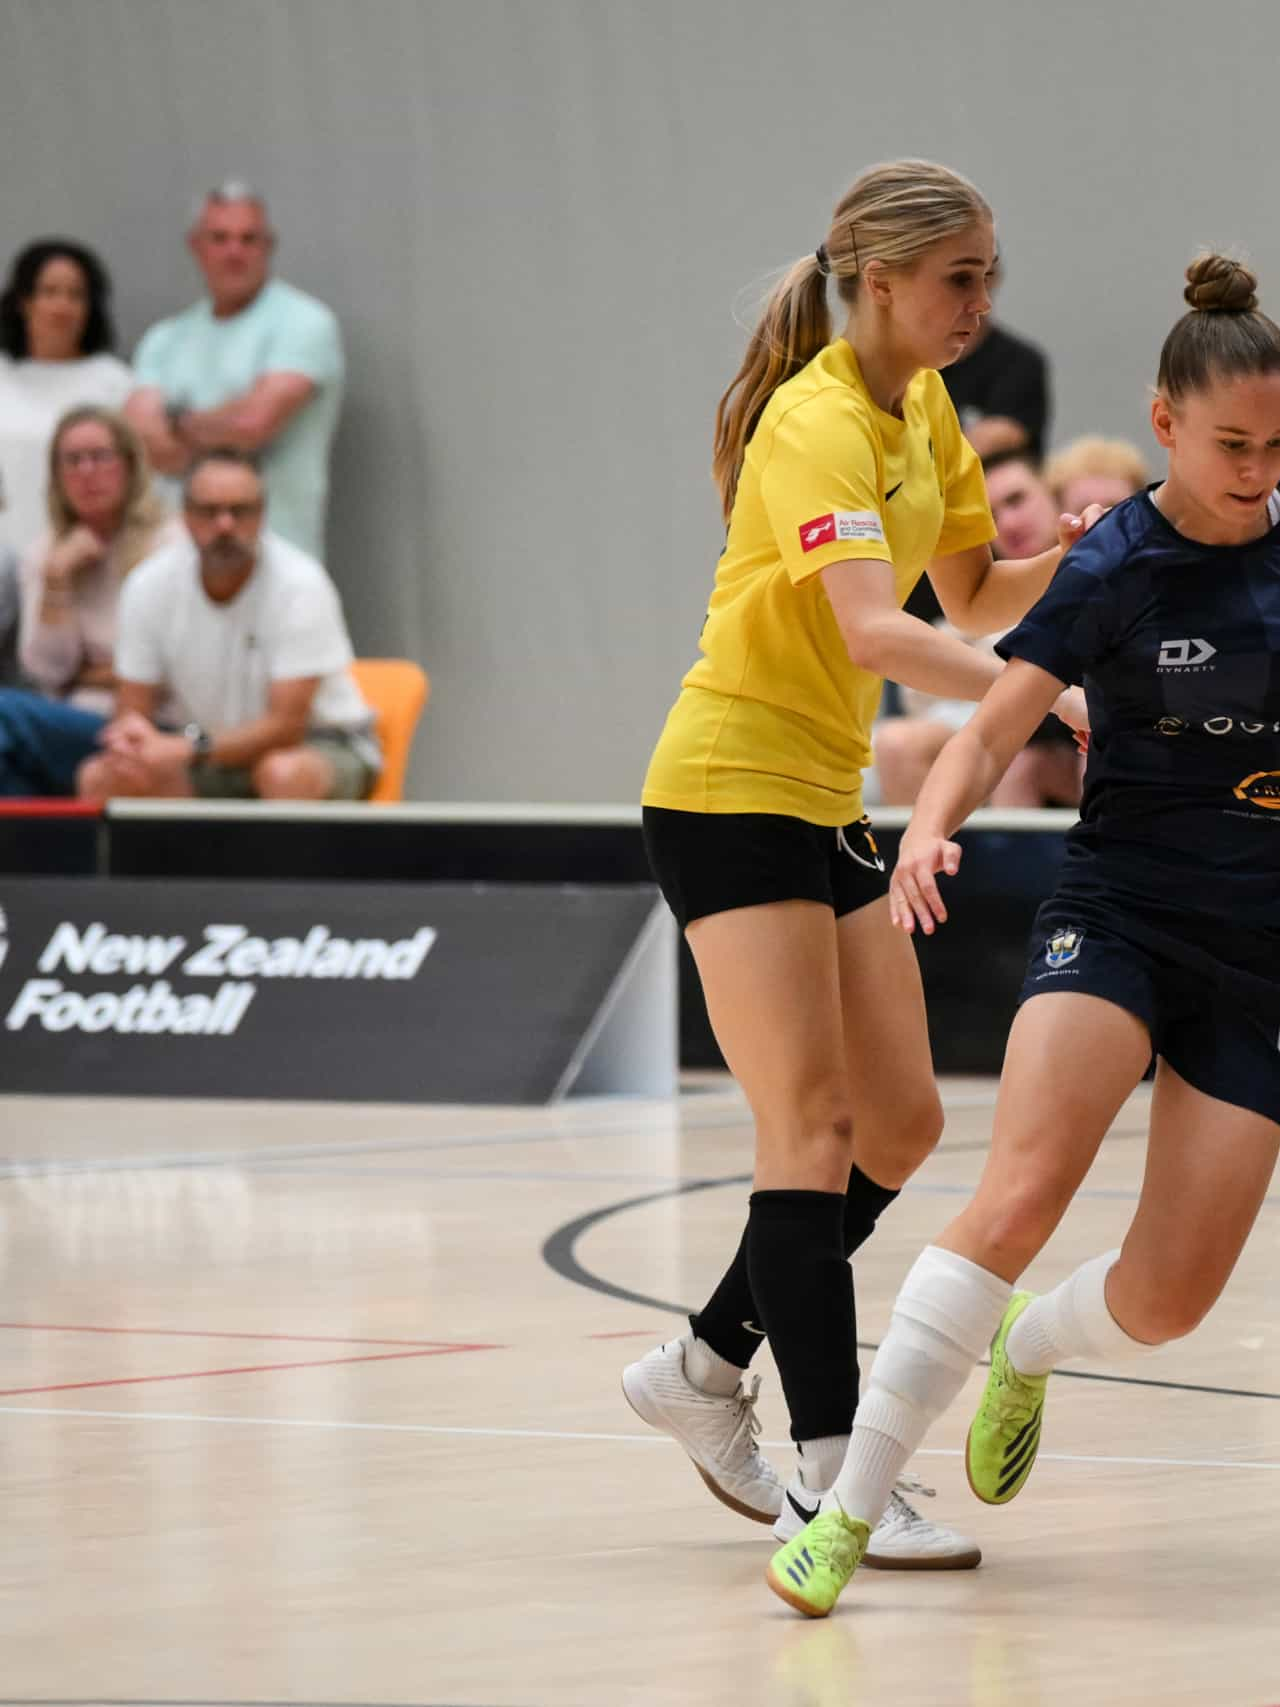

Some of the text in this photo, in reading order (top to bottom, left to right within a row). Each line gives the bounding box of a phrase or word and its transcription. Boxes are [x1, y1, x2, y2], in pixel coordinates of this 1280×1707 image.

[1156, 665, 1215, 673] DYNASTY
[37, 921, 438, 980] New Zealand
[6, 978, 257, 1036] Football
